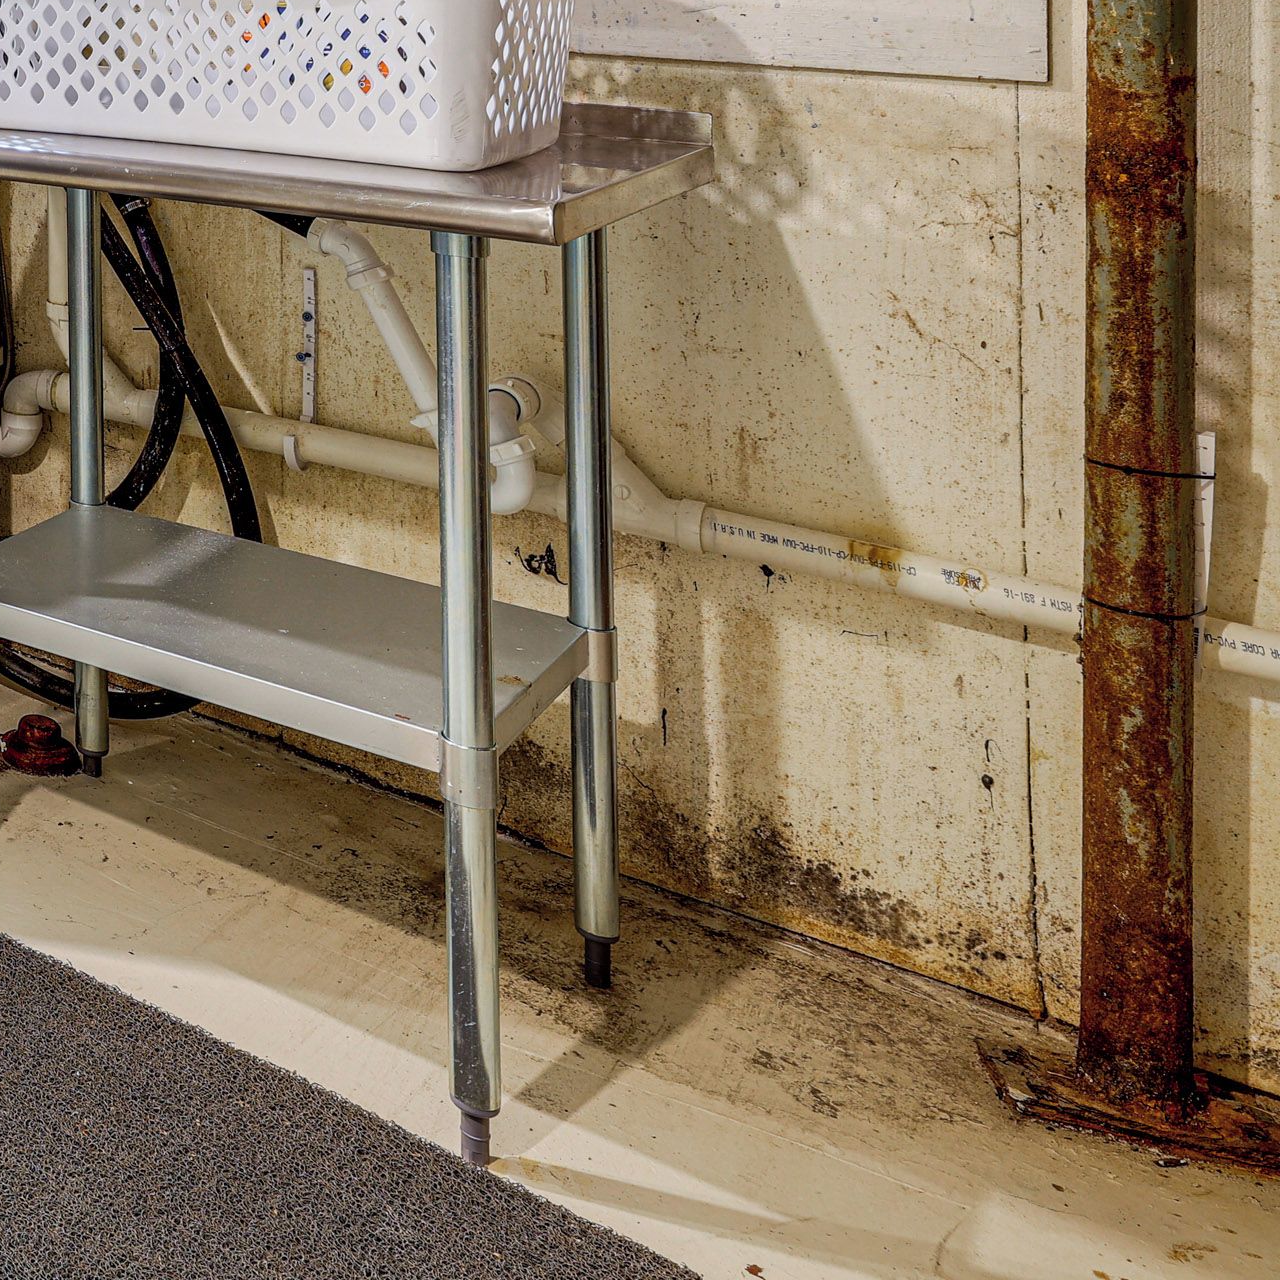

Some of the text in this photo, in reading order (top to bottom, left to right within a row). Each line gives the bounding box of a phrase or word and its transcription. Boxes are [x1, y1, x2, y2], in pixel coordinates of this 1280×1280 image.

[746, 530, 756, 540] IN
[759, 532, 779, 544] MADE
[1002, 588, 1073, 611] ASTM F 891-16
[1240, 642, 1266, 655] CORE
